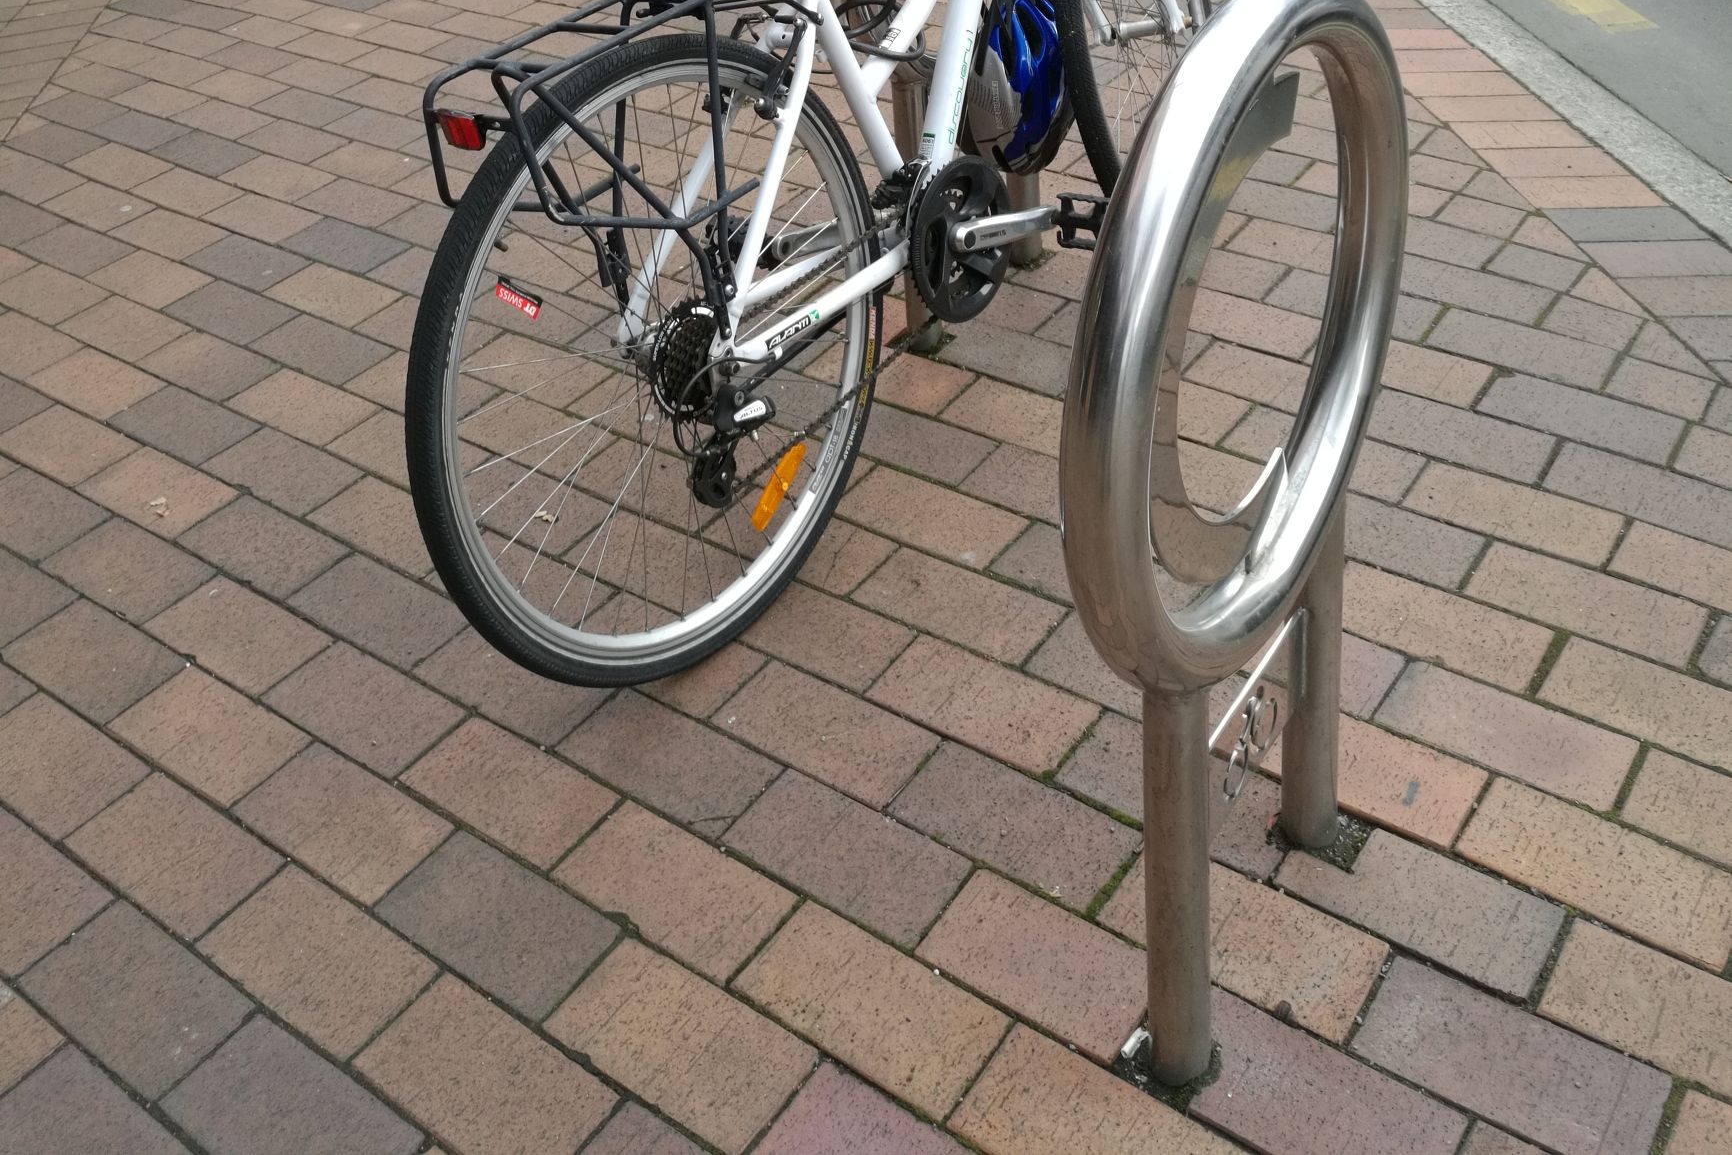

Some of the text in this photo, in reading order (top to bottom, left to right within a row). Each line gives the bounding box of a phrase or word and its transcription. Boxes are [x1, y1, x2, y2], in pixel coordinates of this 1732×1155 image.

[498, 287, 524, 309] SWISS
[523, 301, 537, 317] DT
[769, 316, 810, 350] AVANTI
